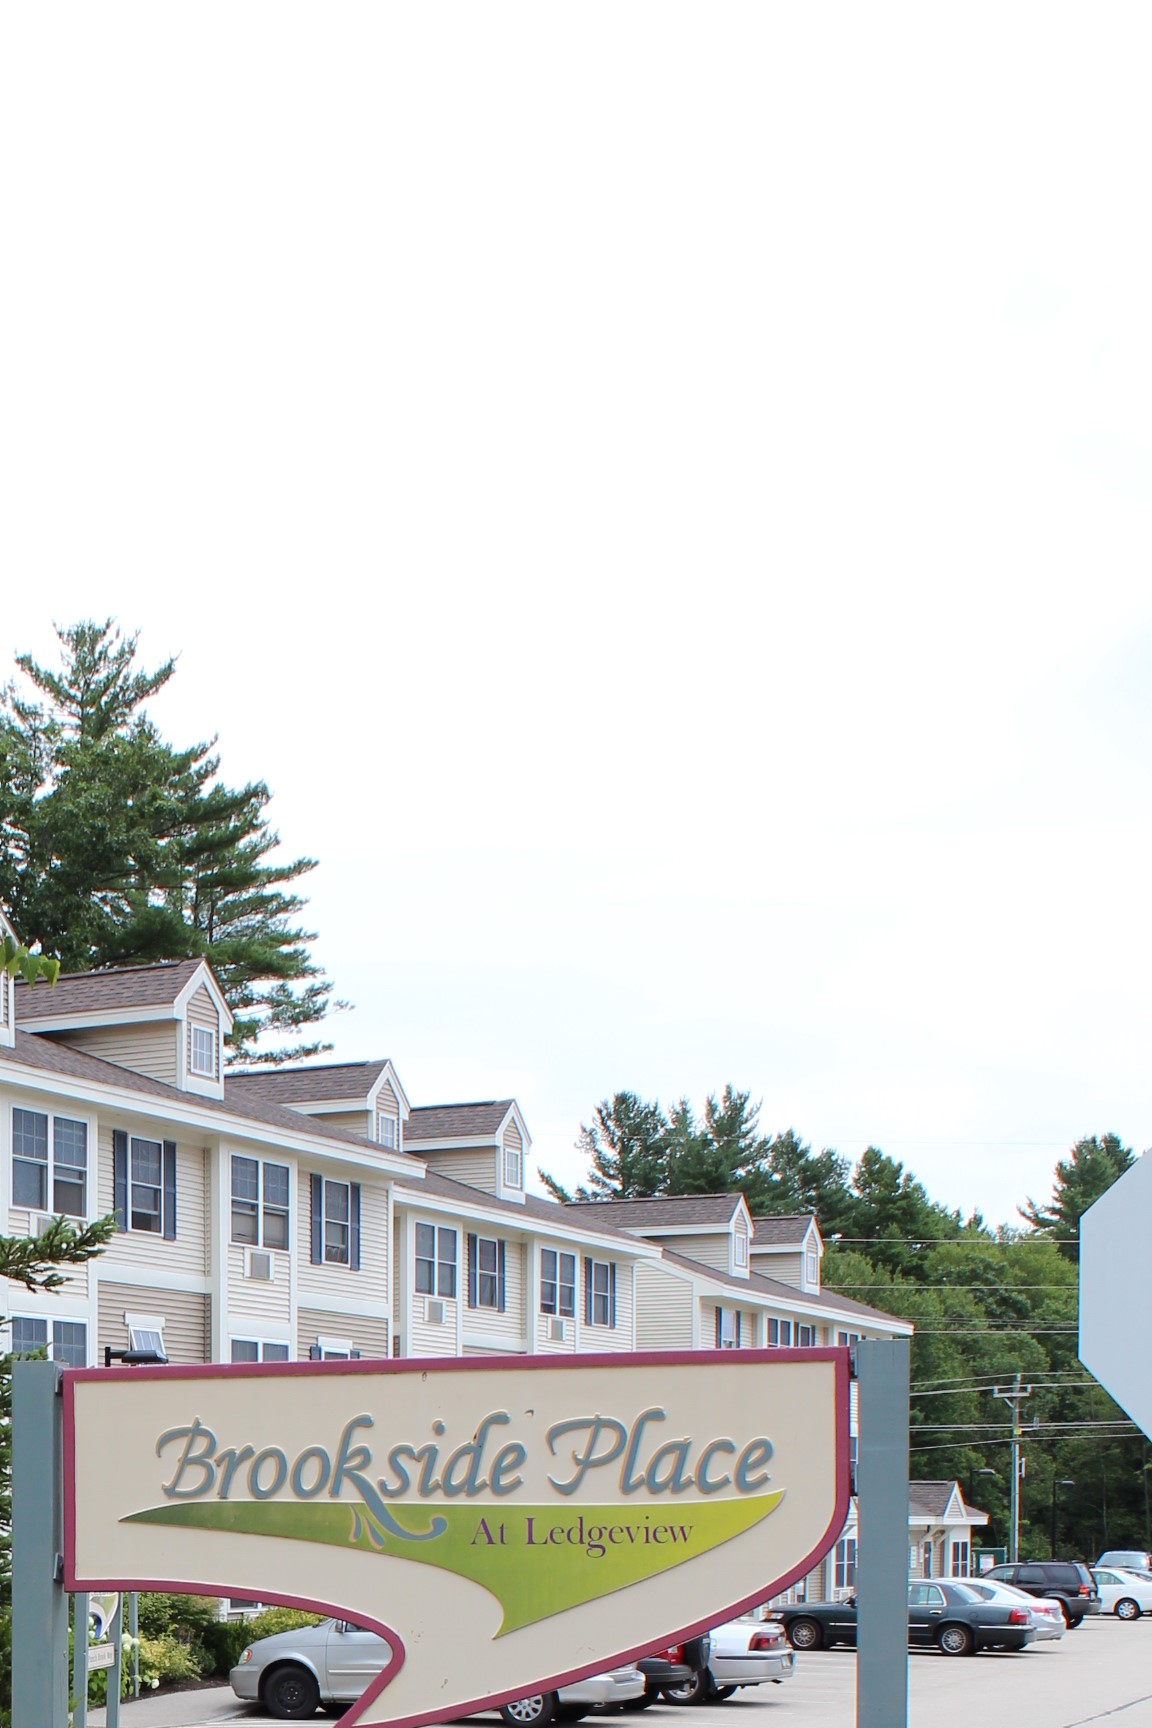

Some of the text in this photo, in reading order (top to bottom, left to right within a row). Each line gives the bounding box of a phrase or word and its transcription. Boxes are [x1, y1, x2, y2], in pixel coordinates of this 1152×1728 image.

[156, 1406, 775, 1542] Brookside Place
[470, 1516, 694, 1559] At Ledgeview
